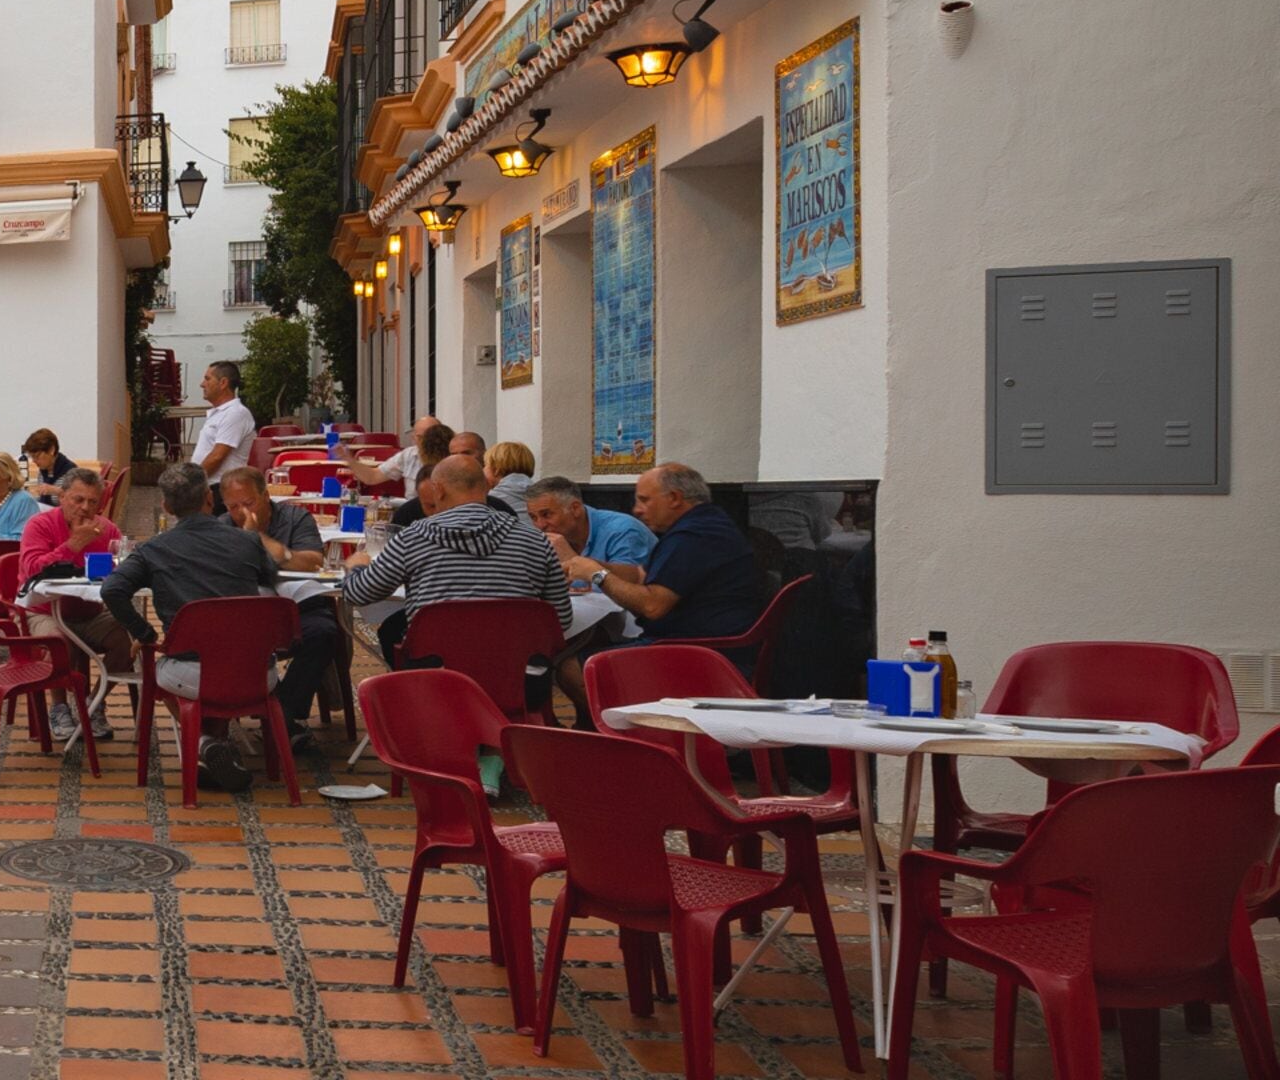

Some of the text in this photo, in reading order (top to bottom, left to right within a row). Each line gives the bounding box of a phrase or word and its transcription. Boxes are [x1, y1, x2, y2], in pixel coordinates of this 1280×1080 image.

[785, 82, 848, 148] ESPECIALIDAD
[807, 143, 822, 175] EN
[786, 169, 847, 229] MARISCOS
